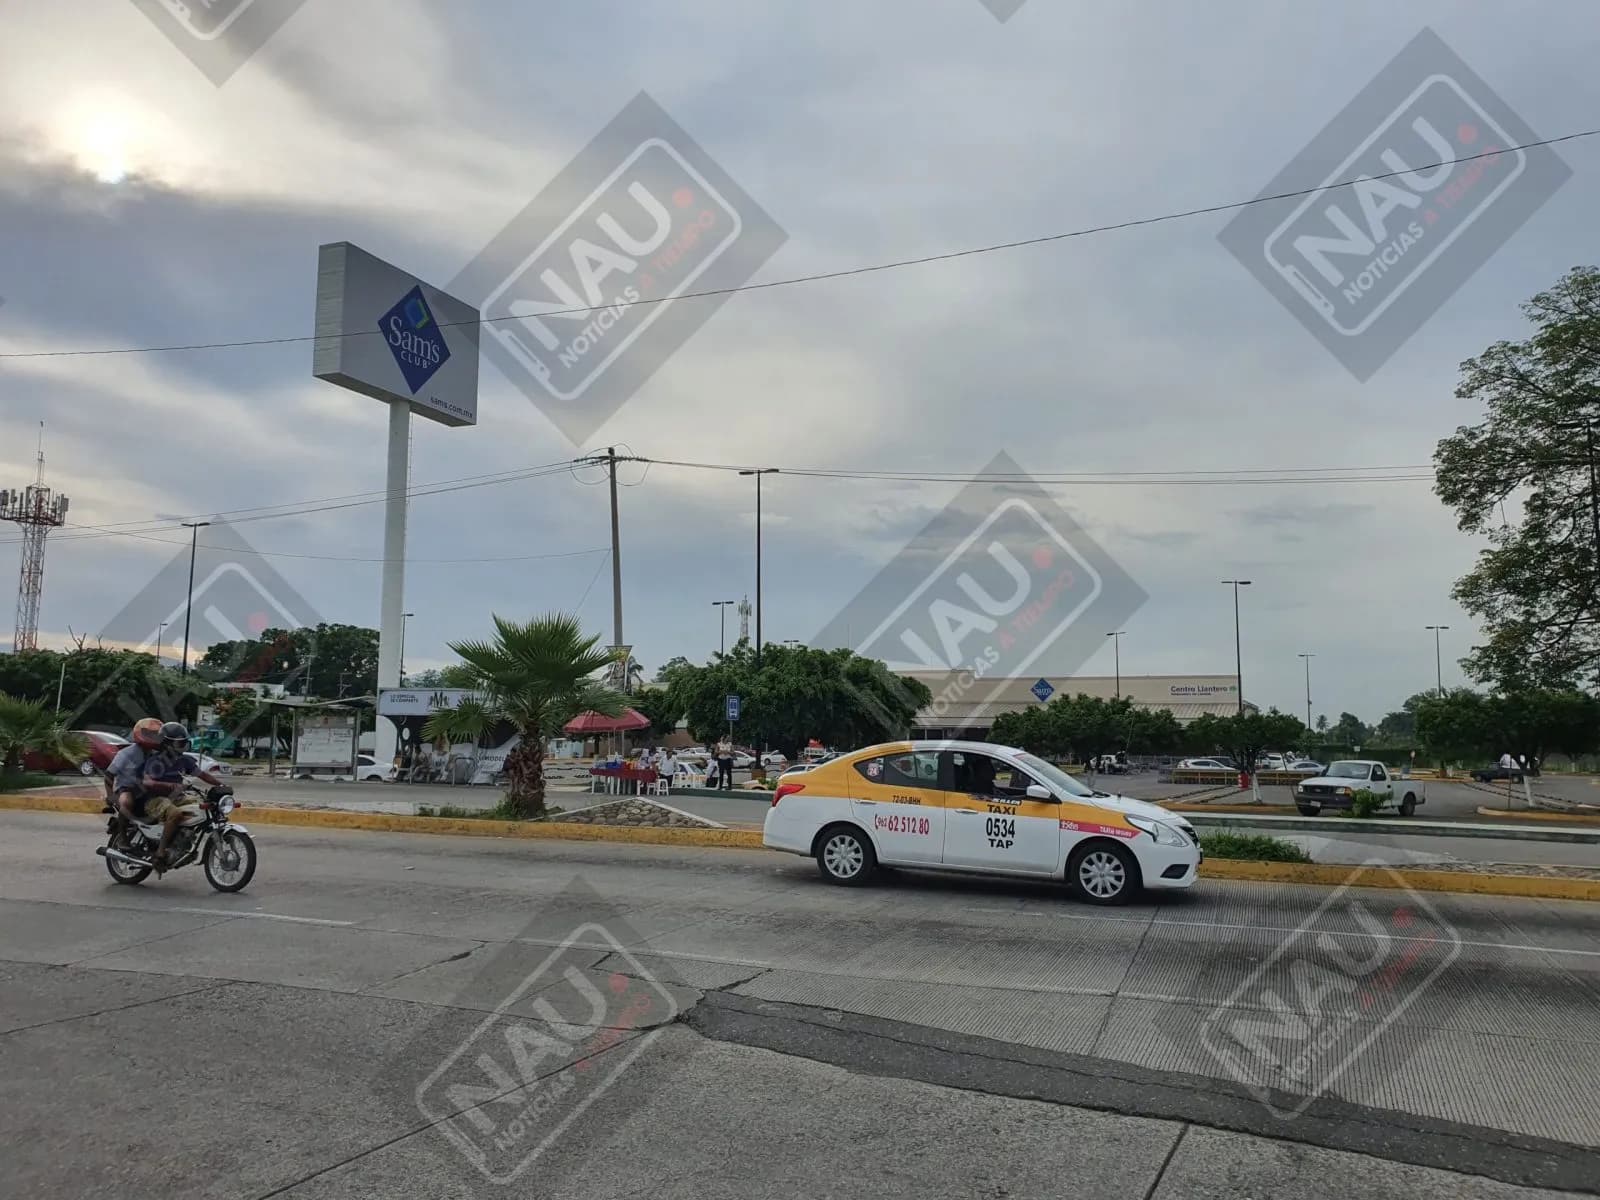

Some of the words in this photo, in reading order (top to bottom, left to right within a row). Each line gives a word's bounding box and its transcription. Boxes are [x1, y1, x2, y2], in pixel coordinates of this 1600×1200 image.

[389, 316, 440, 363] Sam's
[401, 351, 428, 368] CLUB
[987, 804, 1016, 815] TAXI
[888, 815, 899, 831] 62
[901, 816, 917, 833] 512
[919, 817, 930, 835] 80
[986, 817, 1016, 838] 0534
[988, 838, 1013, 849] TAP
